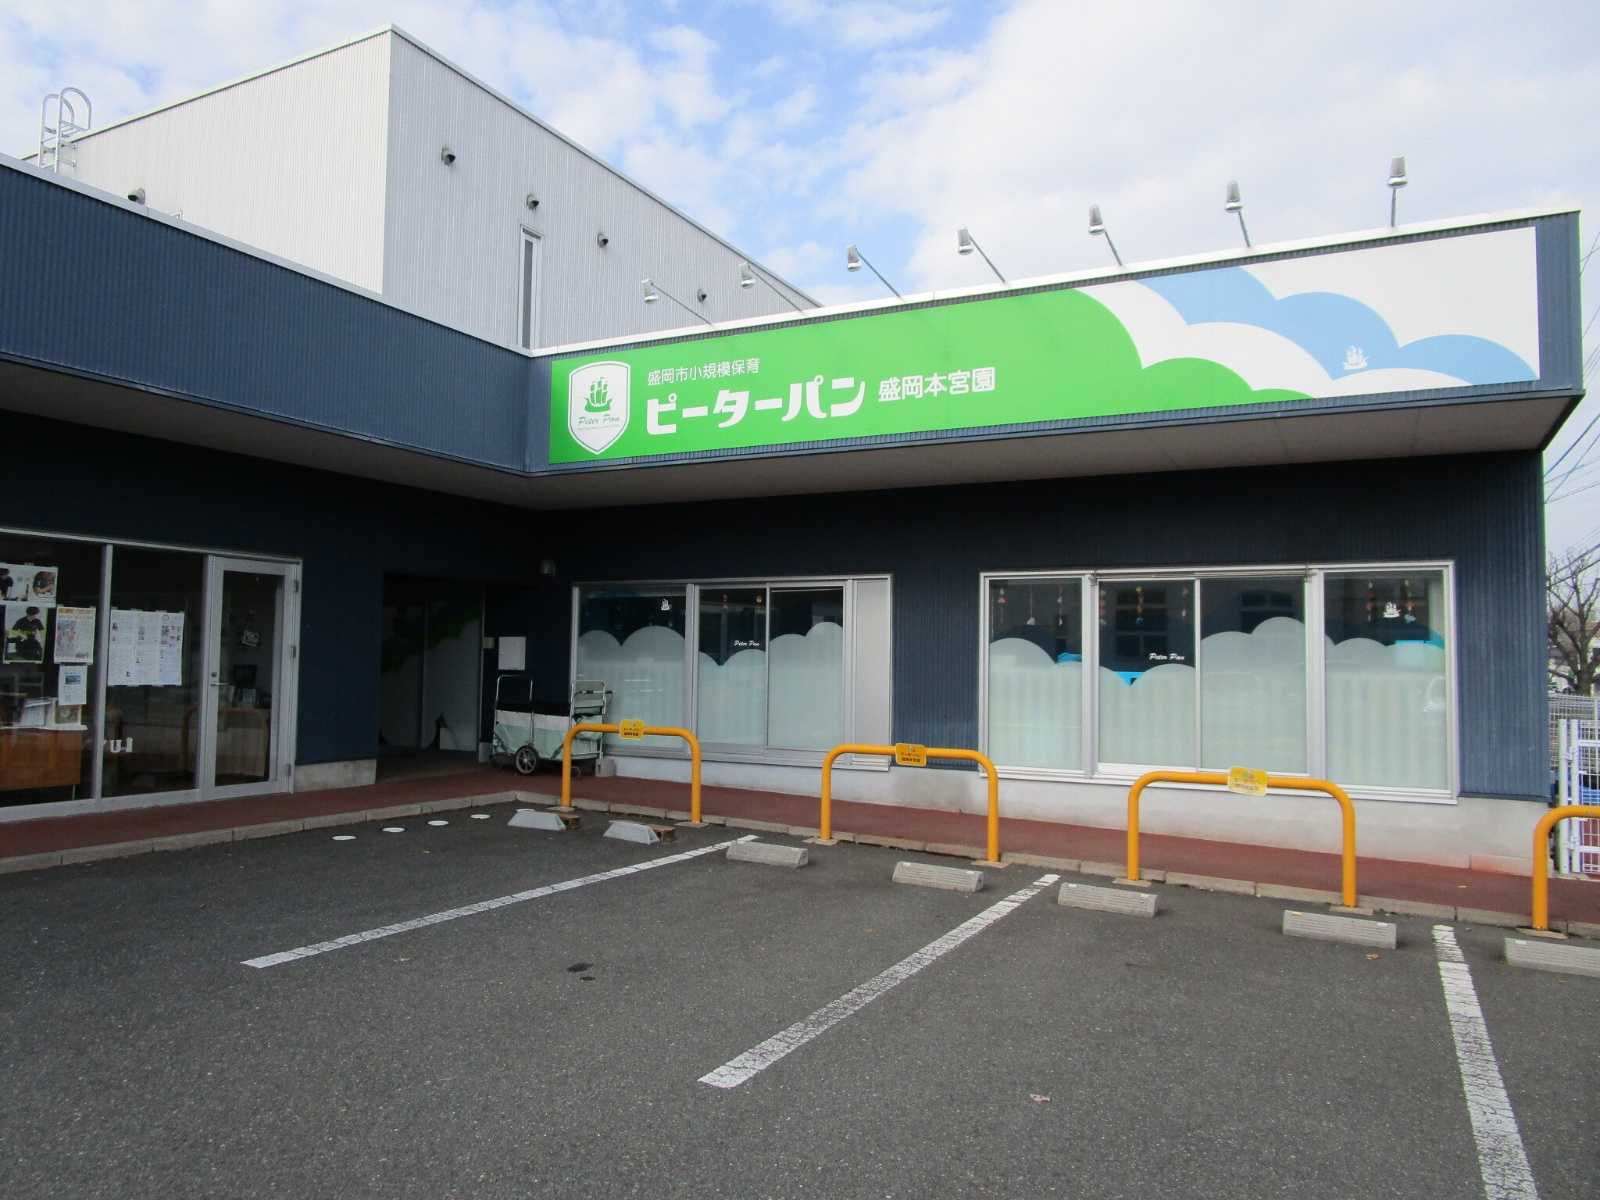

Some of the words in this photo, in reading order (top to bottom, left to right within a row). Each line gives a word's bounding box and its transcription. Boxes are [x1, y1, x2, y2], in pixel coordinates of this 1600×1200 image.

[647, 358, 760, 385] 盛岡市小規模保育
[878, 367, 996, 403] 盛岡本宮園
[646, 374, 867, 435] ピーターパン
